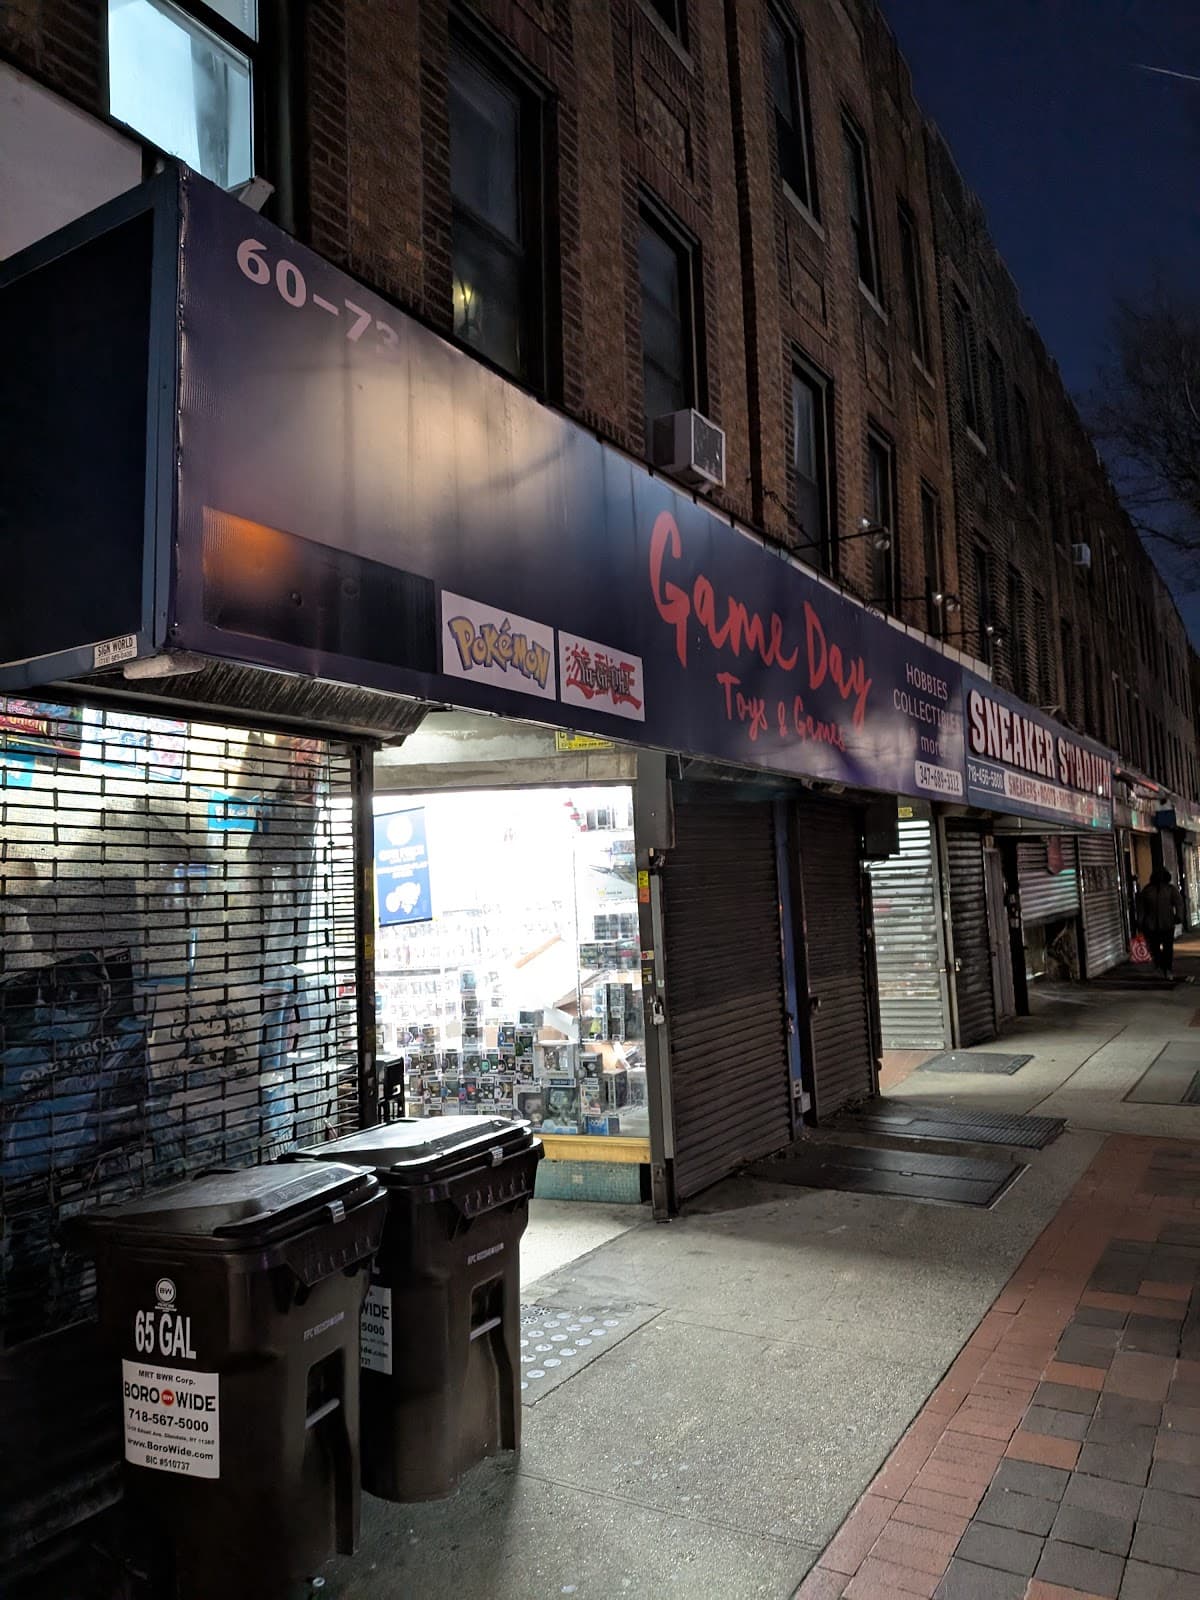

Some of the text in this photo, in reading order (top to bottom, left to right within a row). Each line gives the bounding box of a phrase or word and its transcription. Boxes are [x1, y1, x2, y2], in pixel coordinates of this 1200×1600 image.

[649, 510, 873, 735] Game Day
[98, 643, 111, 657] SIGN
[112, 637, 133, 652] WORLD
[905, 663, 948, 701] HOBBIES
[716, 671, 847, 753] Toys & Games
[920, 734, 946, 759] more
[969, 688, 1111, 800] SNEAKER STADIUM
[135, 1310, 197, 1360] 65 GAL
[175, 1376, 196, 1386] Corp.
[124, 1381, 160, 1404] BORO
[176, 1391, 216, 1412] WIDE
[128, 1408, 209, 1433] 718-567-5000
[127, 1438, 214, 1460] www.BoroWide.com
[145, 1454, 158, 1465] BIC
